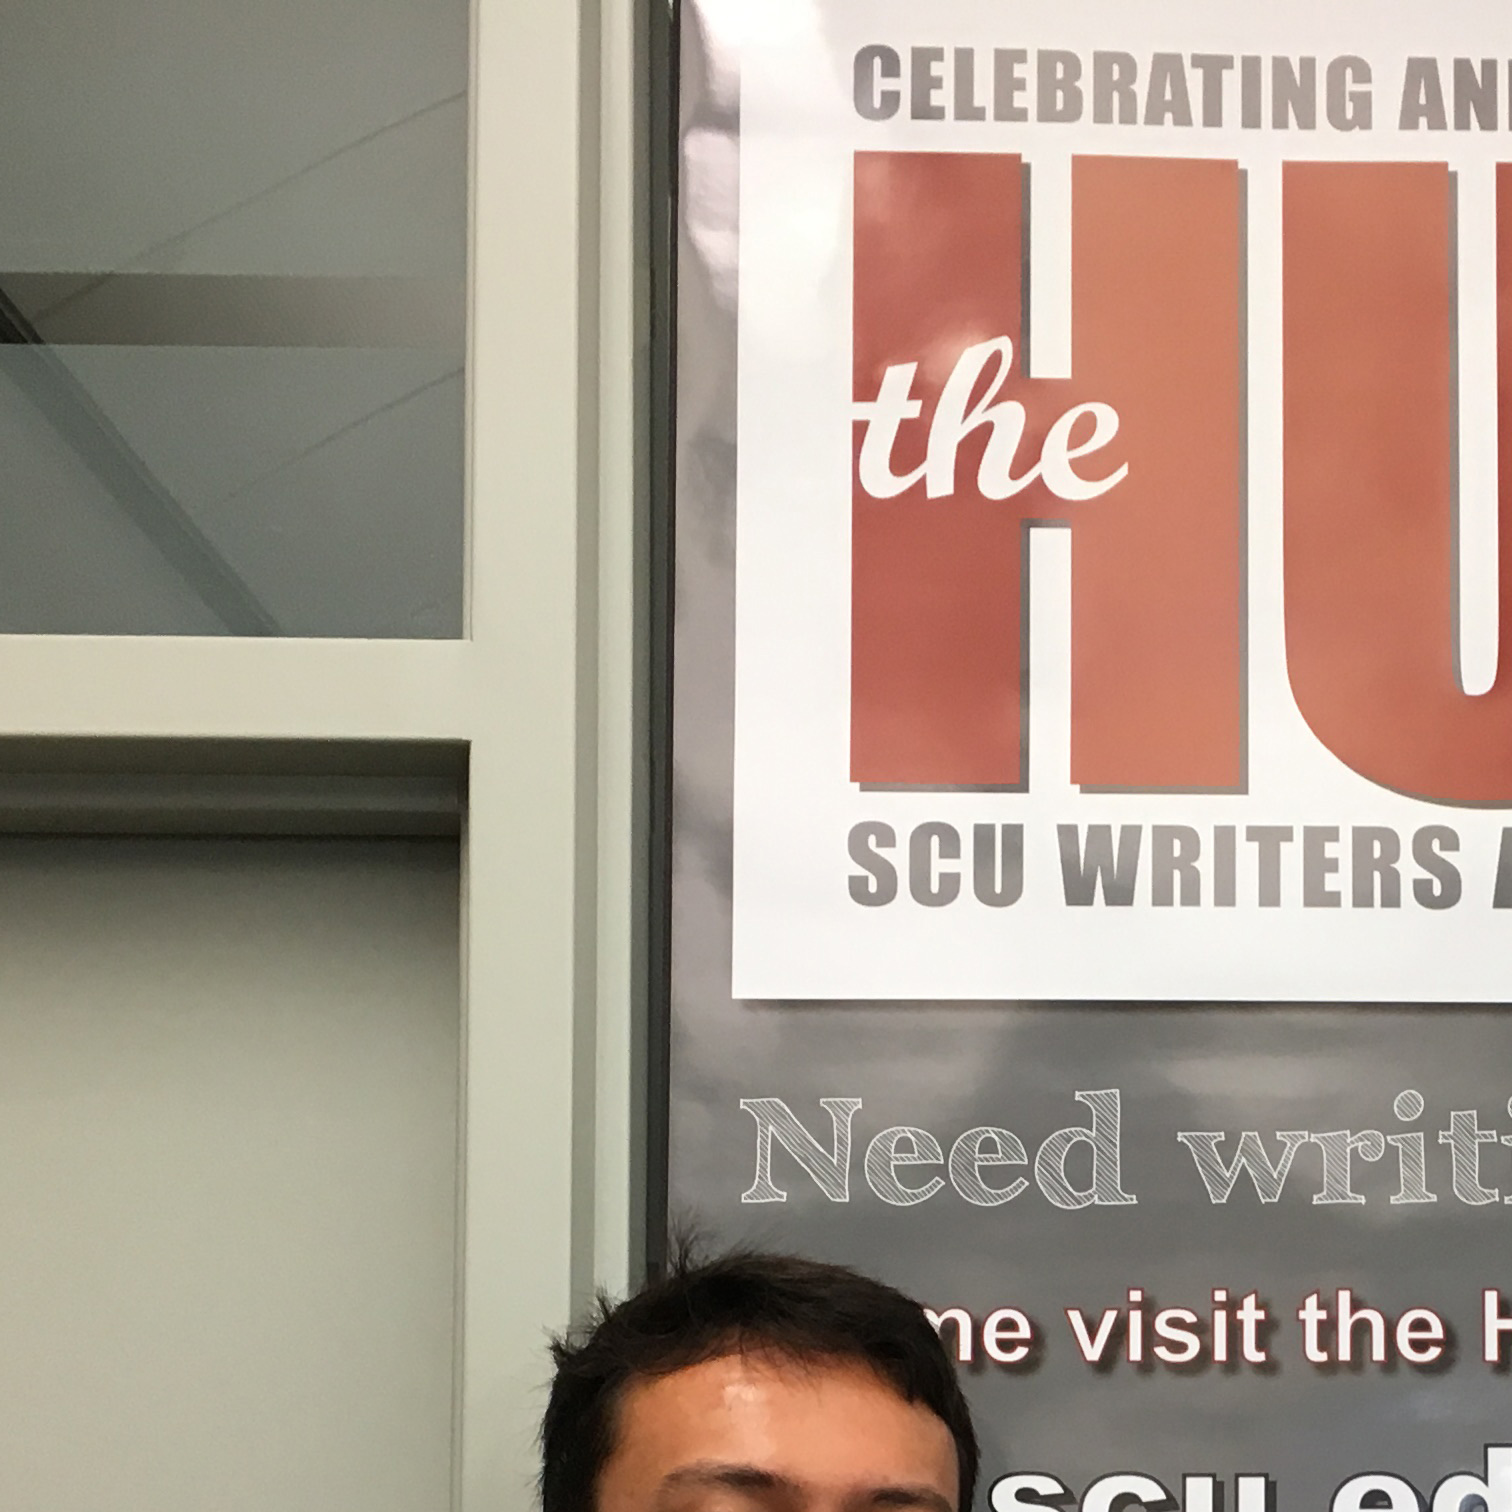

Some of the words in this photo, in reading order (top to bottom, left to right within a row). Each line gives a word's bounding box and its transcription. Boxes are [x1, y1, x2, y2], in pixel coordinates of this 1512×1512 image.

[852, 44, 1374, 132] CELEBRATING
[851, 335, 1130, 502] the
[847, 820, 1026, 909] SCU
[1057, 823, 1462, 911] WRITERS
[739, 1088, 1138, 1209] Need
[1068, 1287, 1268, 1365] visit
[1297, 1287, 1447, 1366] the
